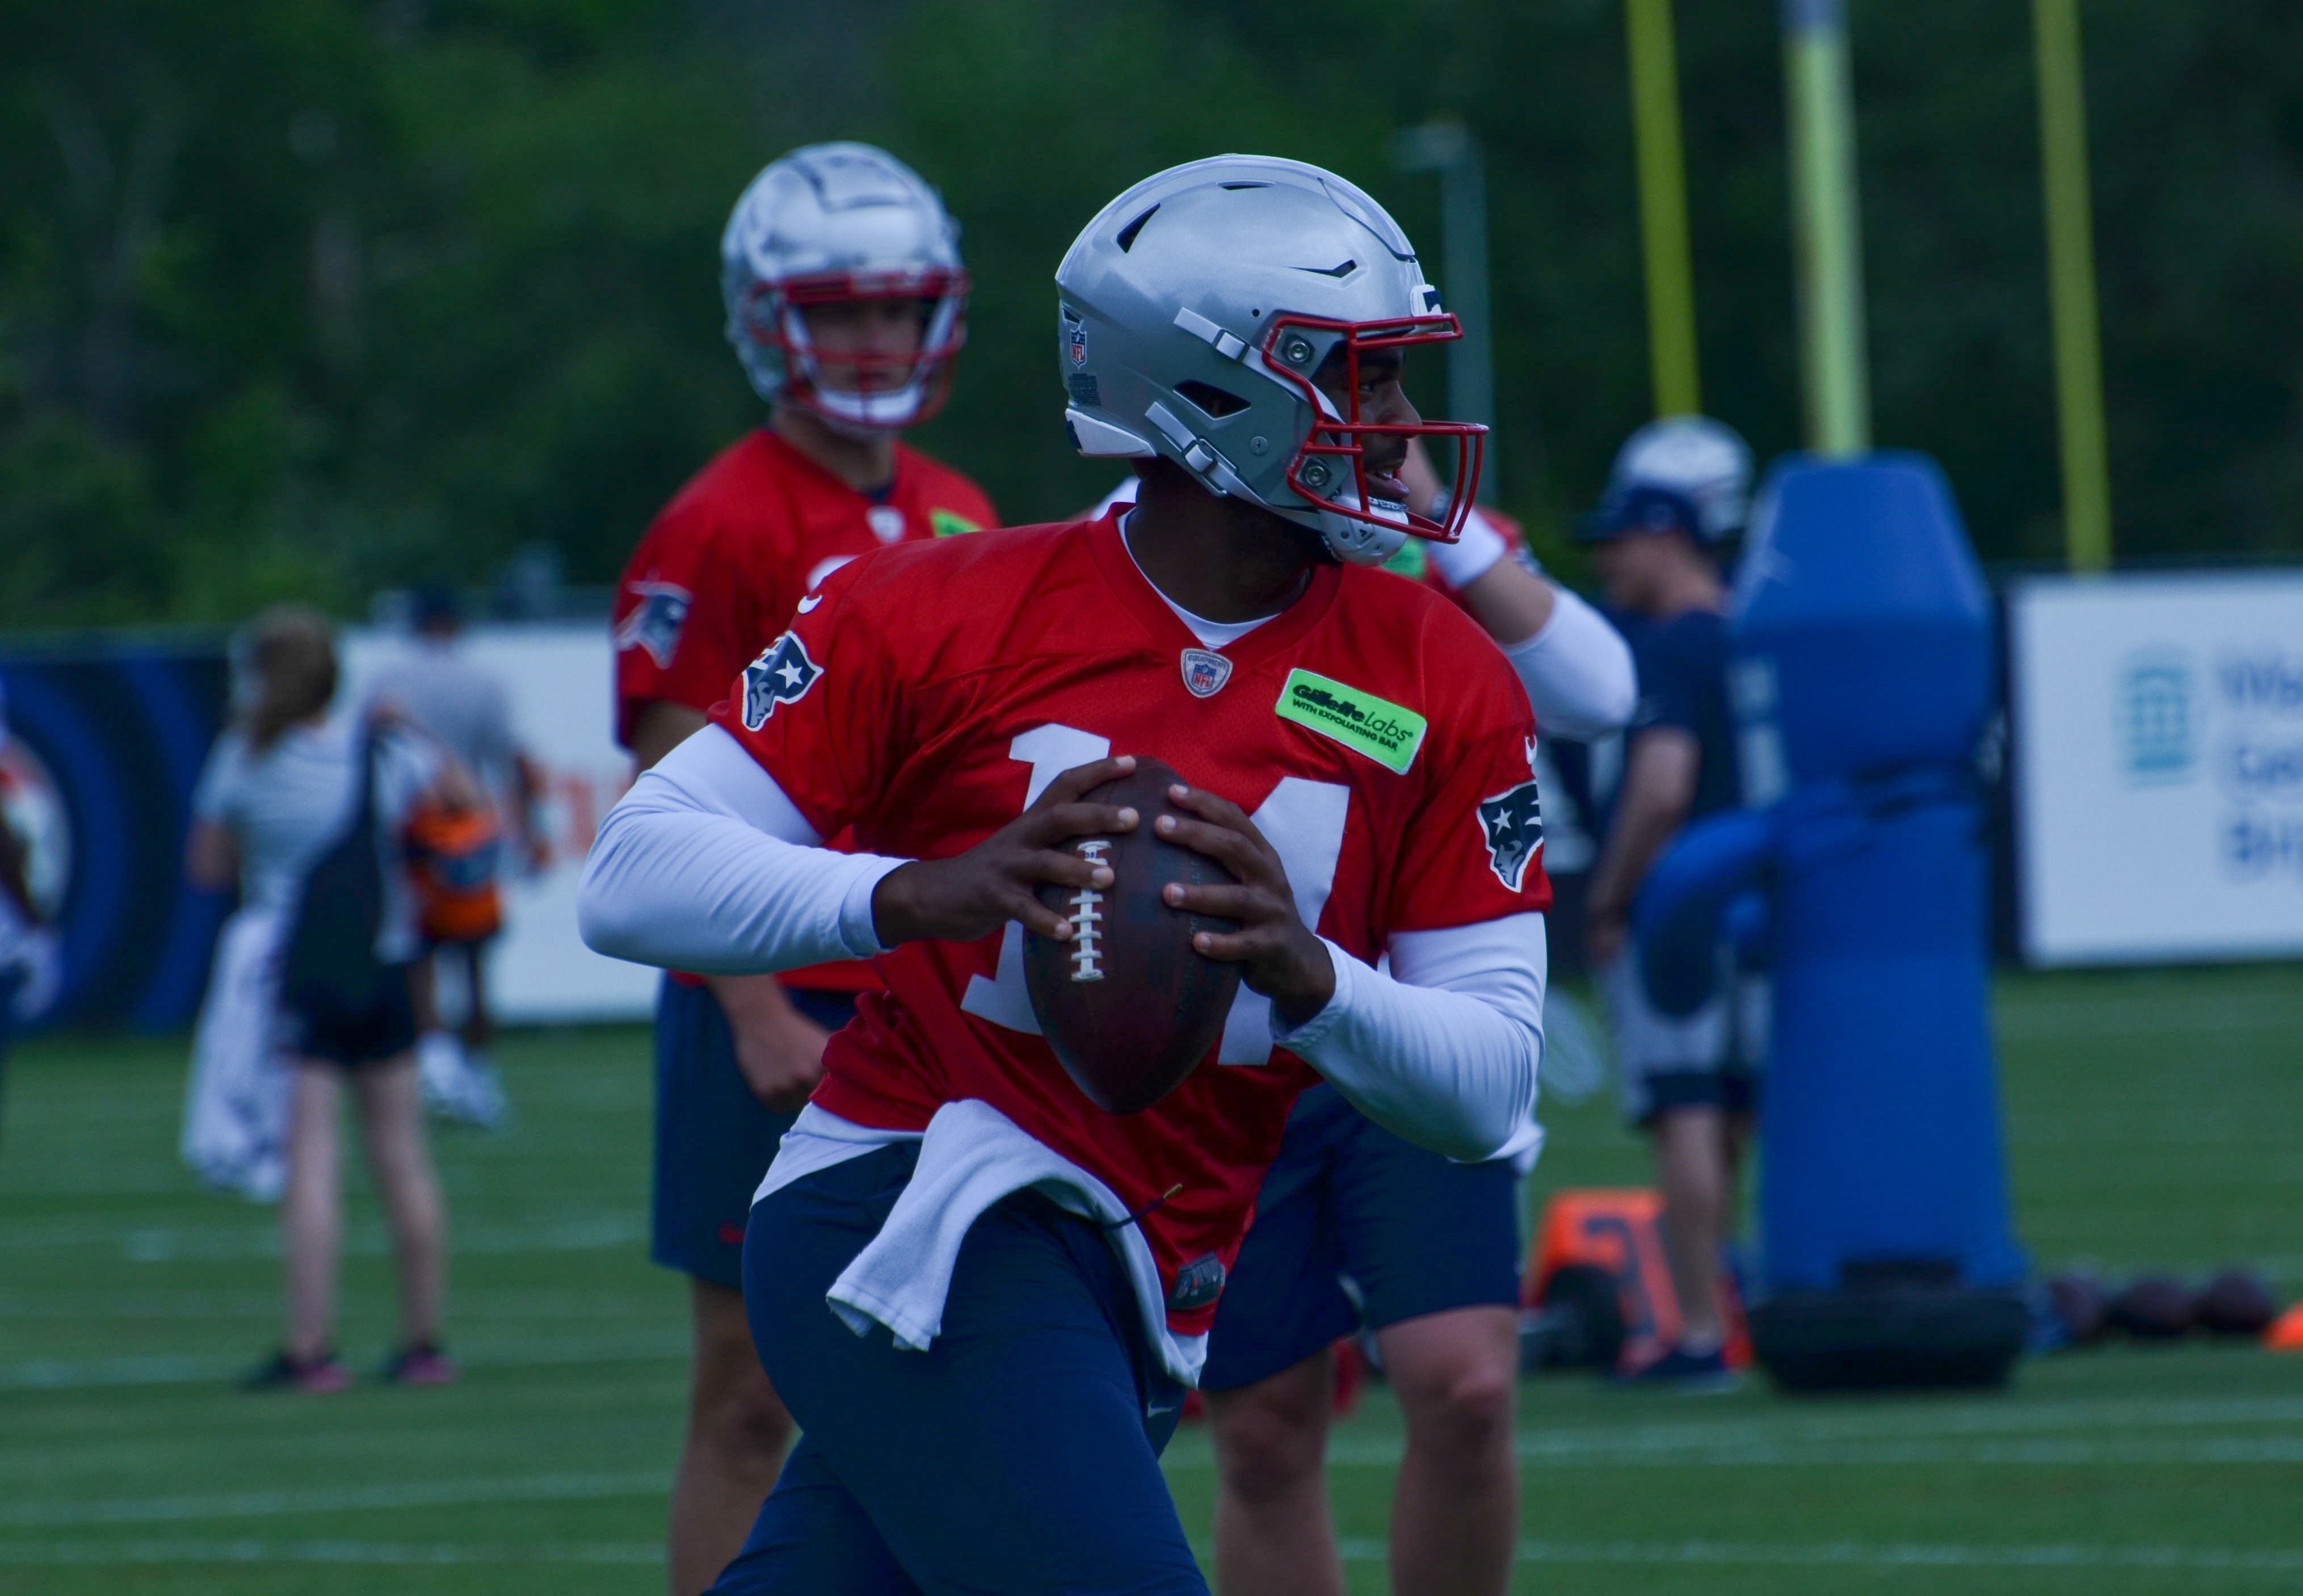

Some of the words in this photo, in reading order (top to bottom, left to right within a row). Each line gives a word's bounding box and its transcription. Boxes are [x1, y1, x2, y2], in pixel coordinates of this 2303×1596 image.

[1071, 344, 1085, 360] NFL
[1188, 654, 1227, 669] EQUIPMENT
[1193, 673, 1212, 687] NFL
[1292, 699, 1317, 715] WITH
[1318, 709, 1377, 742] EXFOLIATING
[1378, 737, 1398, 751] BAR
